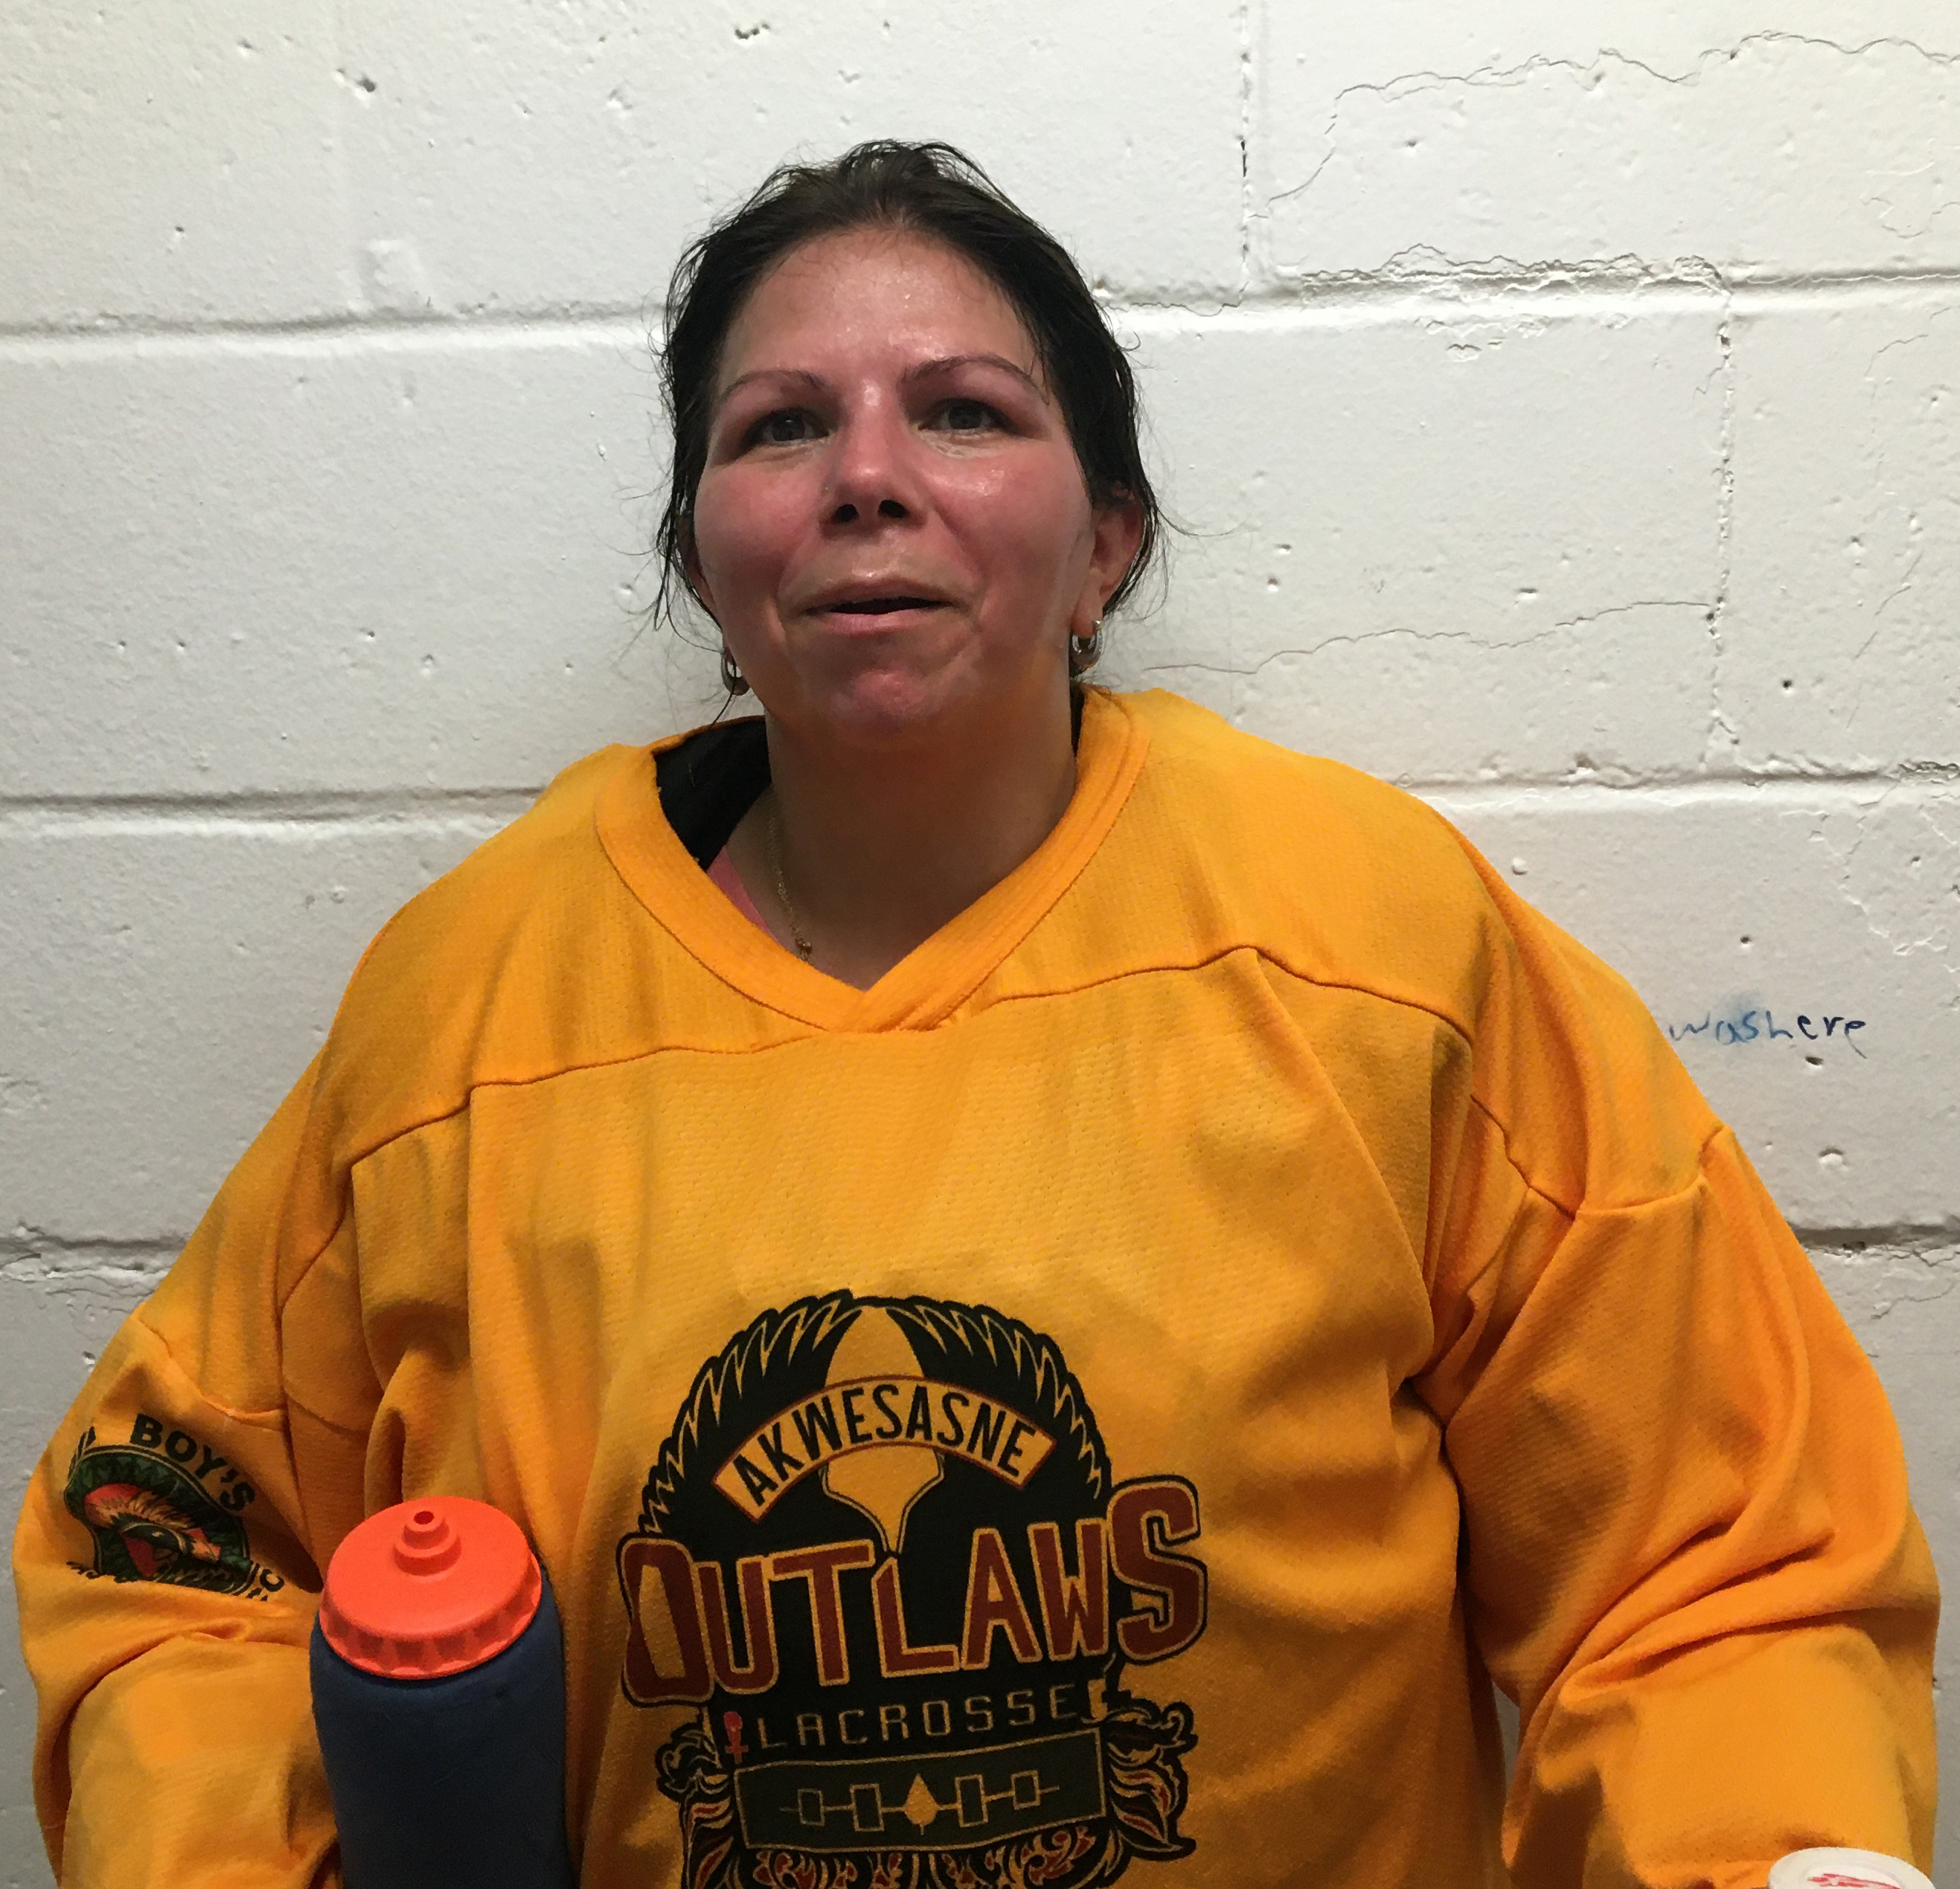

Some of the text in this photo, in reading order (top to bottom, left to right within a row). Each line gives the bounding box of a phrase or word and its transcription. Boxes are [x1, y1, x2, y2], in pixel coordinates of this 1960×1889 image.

[129, 1414, 257, 1513] BOY'S
[732, 1381, 1039, 1506] AKWESASNE
[619, 1475, 1208, 1707] OUTLAWS
[758, 1684, 1076, 1749] LACROSSE
